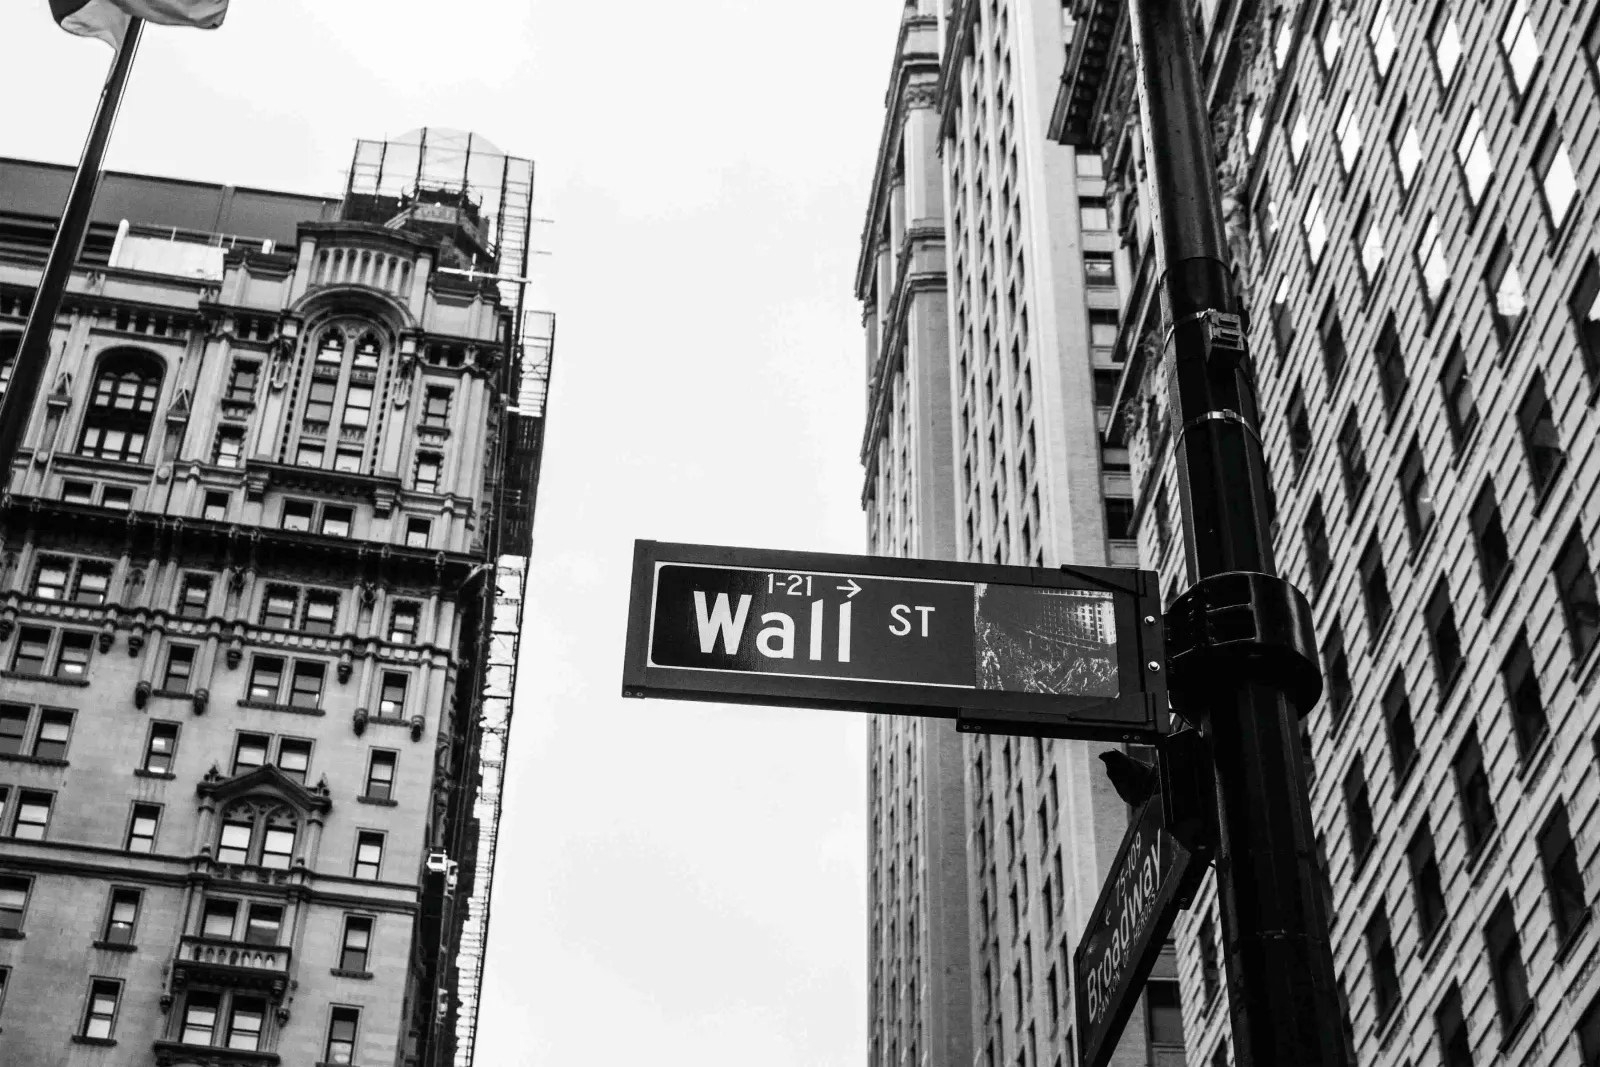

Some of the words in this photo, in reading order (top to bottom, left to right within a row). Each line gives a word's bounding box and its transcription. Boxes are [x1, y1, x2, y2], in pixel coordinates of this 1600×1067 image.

[767, 573, 813, 597] 1-21
[693, 590, 852, 663] Wall
[888, 604, 936, 638] ST
[1115, 831, 1141, 907] 75-109
[1087, 827, 1161, 1024] Broadway
[1097, 965, 1121, 1024] CANYON
[1123, 941, 1132, 969] OF
[1133, 887, 1156, 946] HEROES
